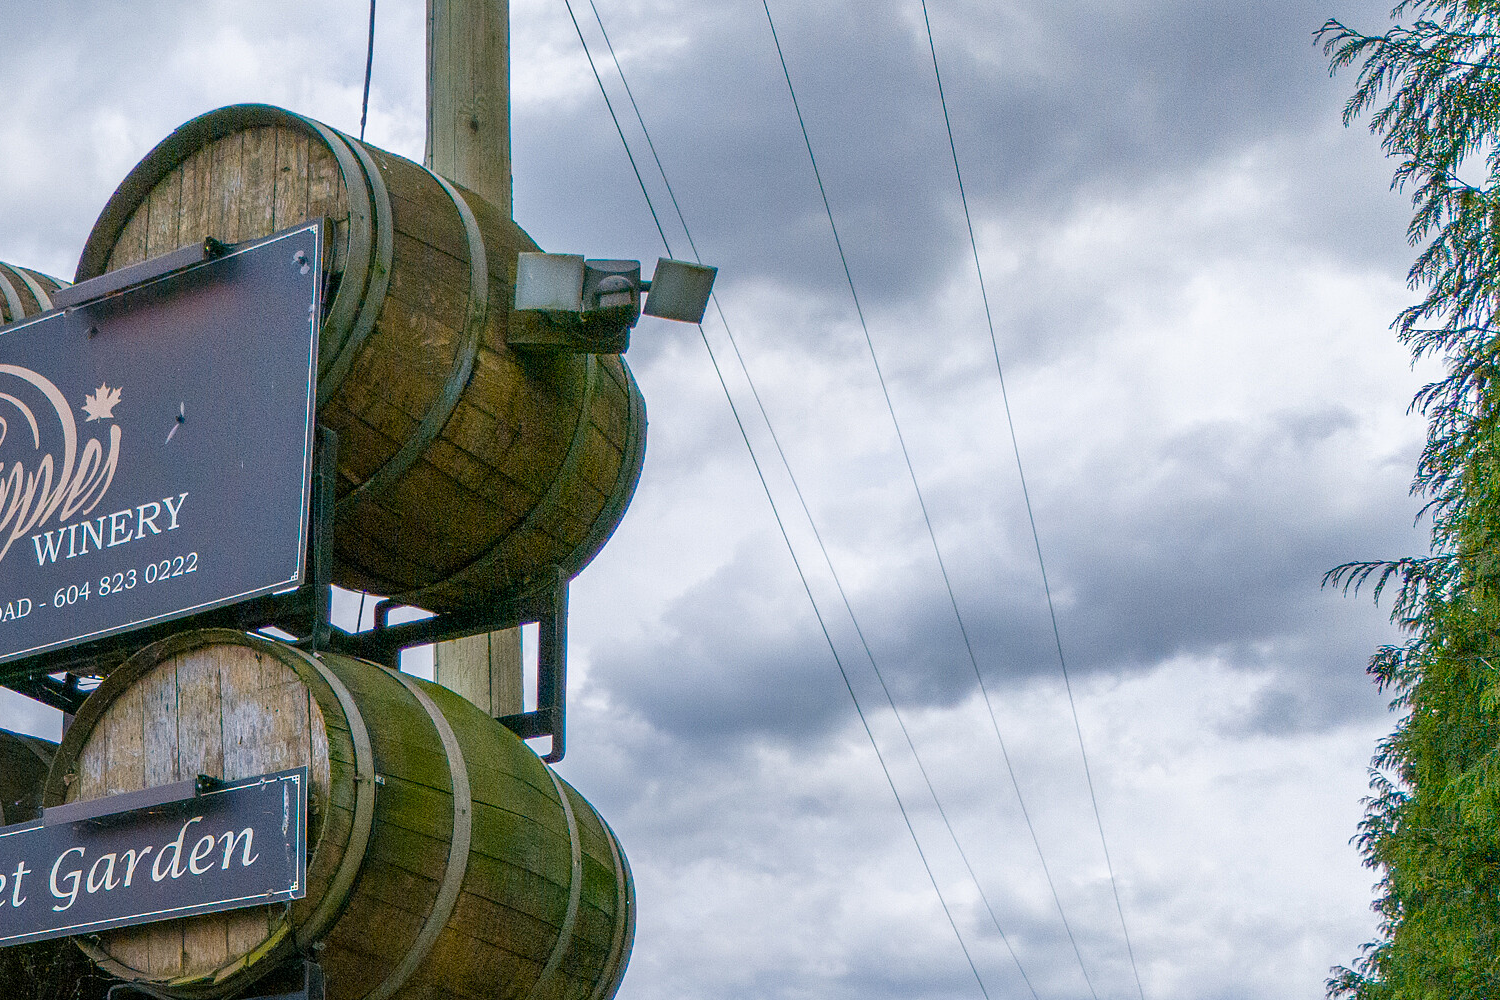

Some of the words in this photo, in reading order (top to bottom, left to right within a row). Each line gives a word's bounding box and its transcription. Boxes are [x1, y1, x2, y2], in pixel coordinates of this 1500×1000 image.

[31, 492, 189, 567] WINERY
[53, 581, 91, 608] 604
[98, 569, 137, 596] 823
[144, 552, 199, 584] 0222
[49, 816, 259, 912] Garden
